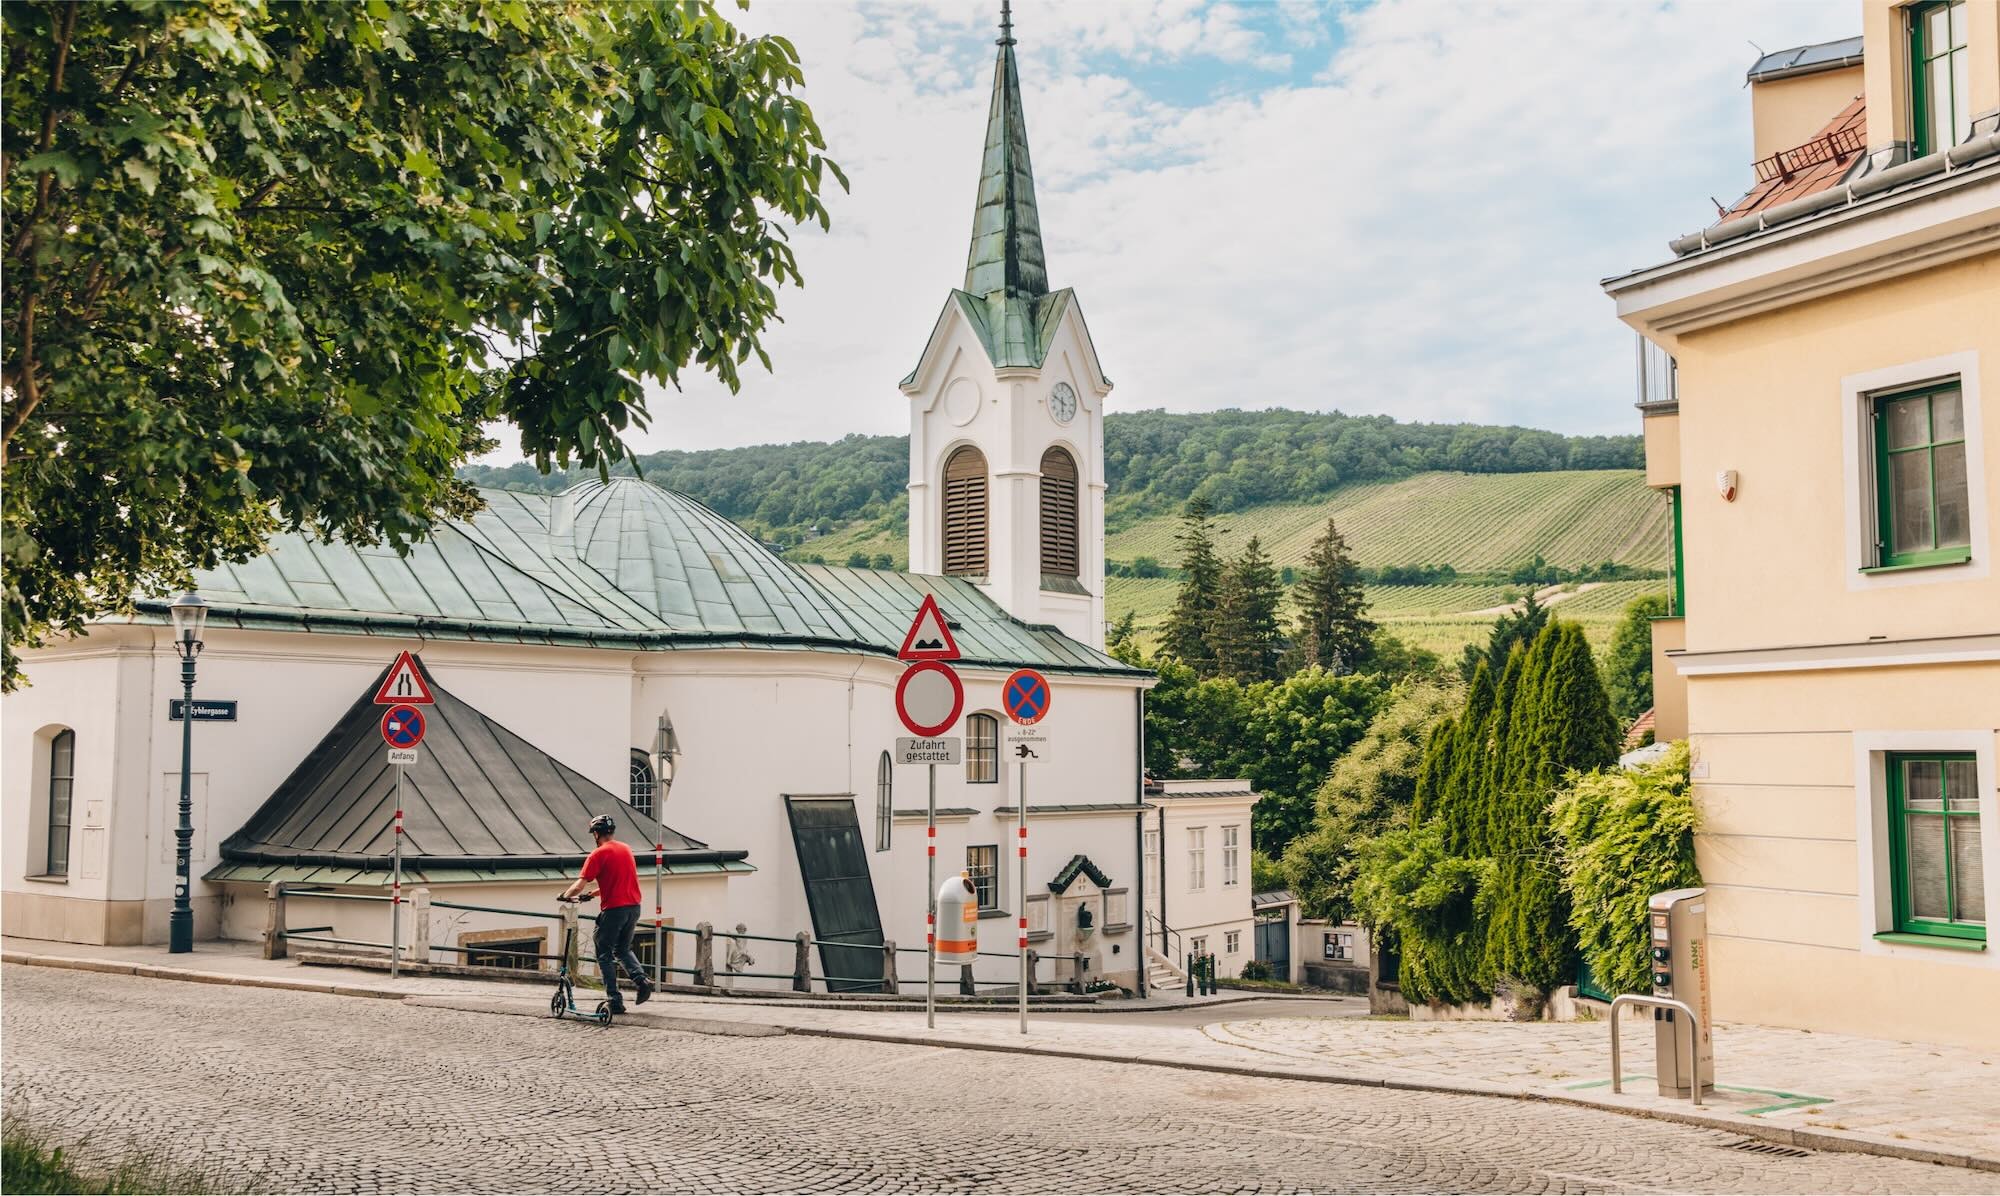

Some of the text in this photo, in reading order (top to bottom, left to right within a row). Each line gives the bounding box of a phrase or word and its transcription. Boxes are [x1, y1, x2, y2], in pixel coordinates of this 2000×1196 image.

[1018, 717, 1036, 725] ENDE
[910, 740, 945, 750] Zufahrt
[391, 752, 415, 761] Anfang
[906, 752, 950, 762] gestattet
[1691, 939, 1699, 971] TANKE
